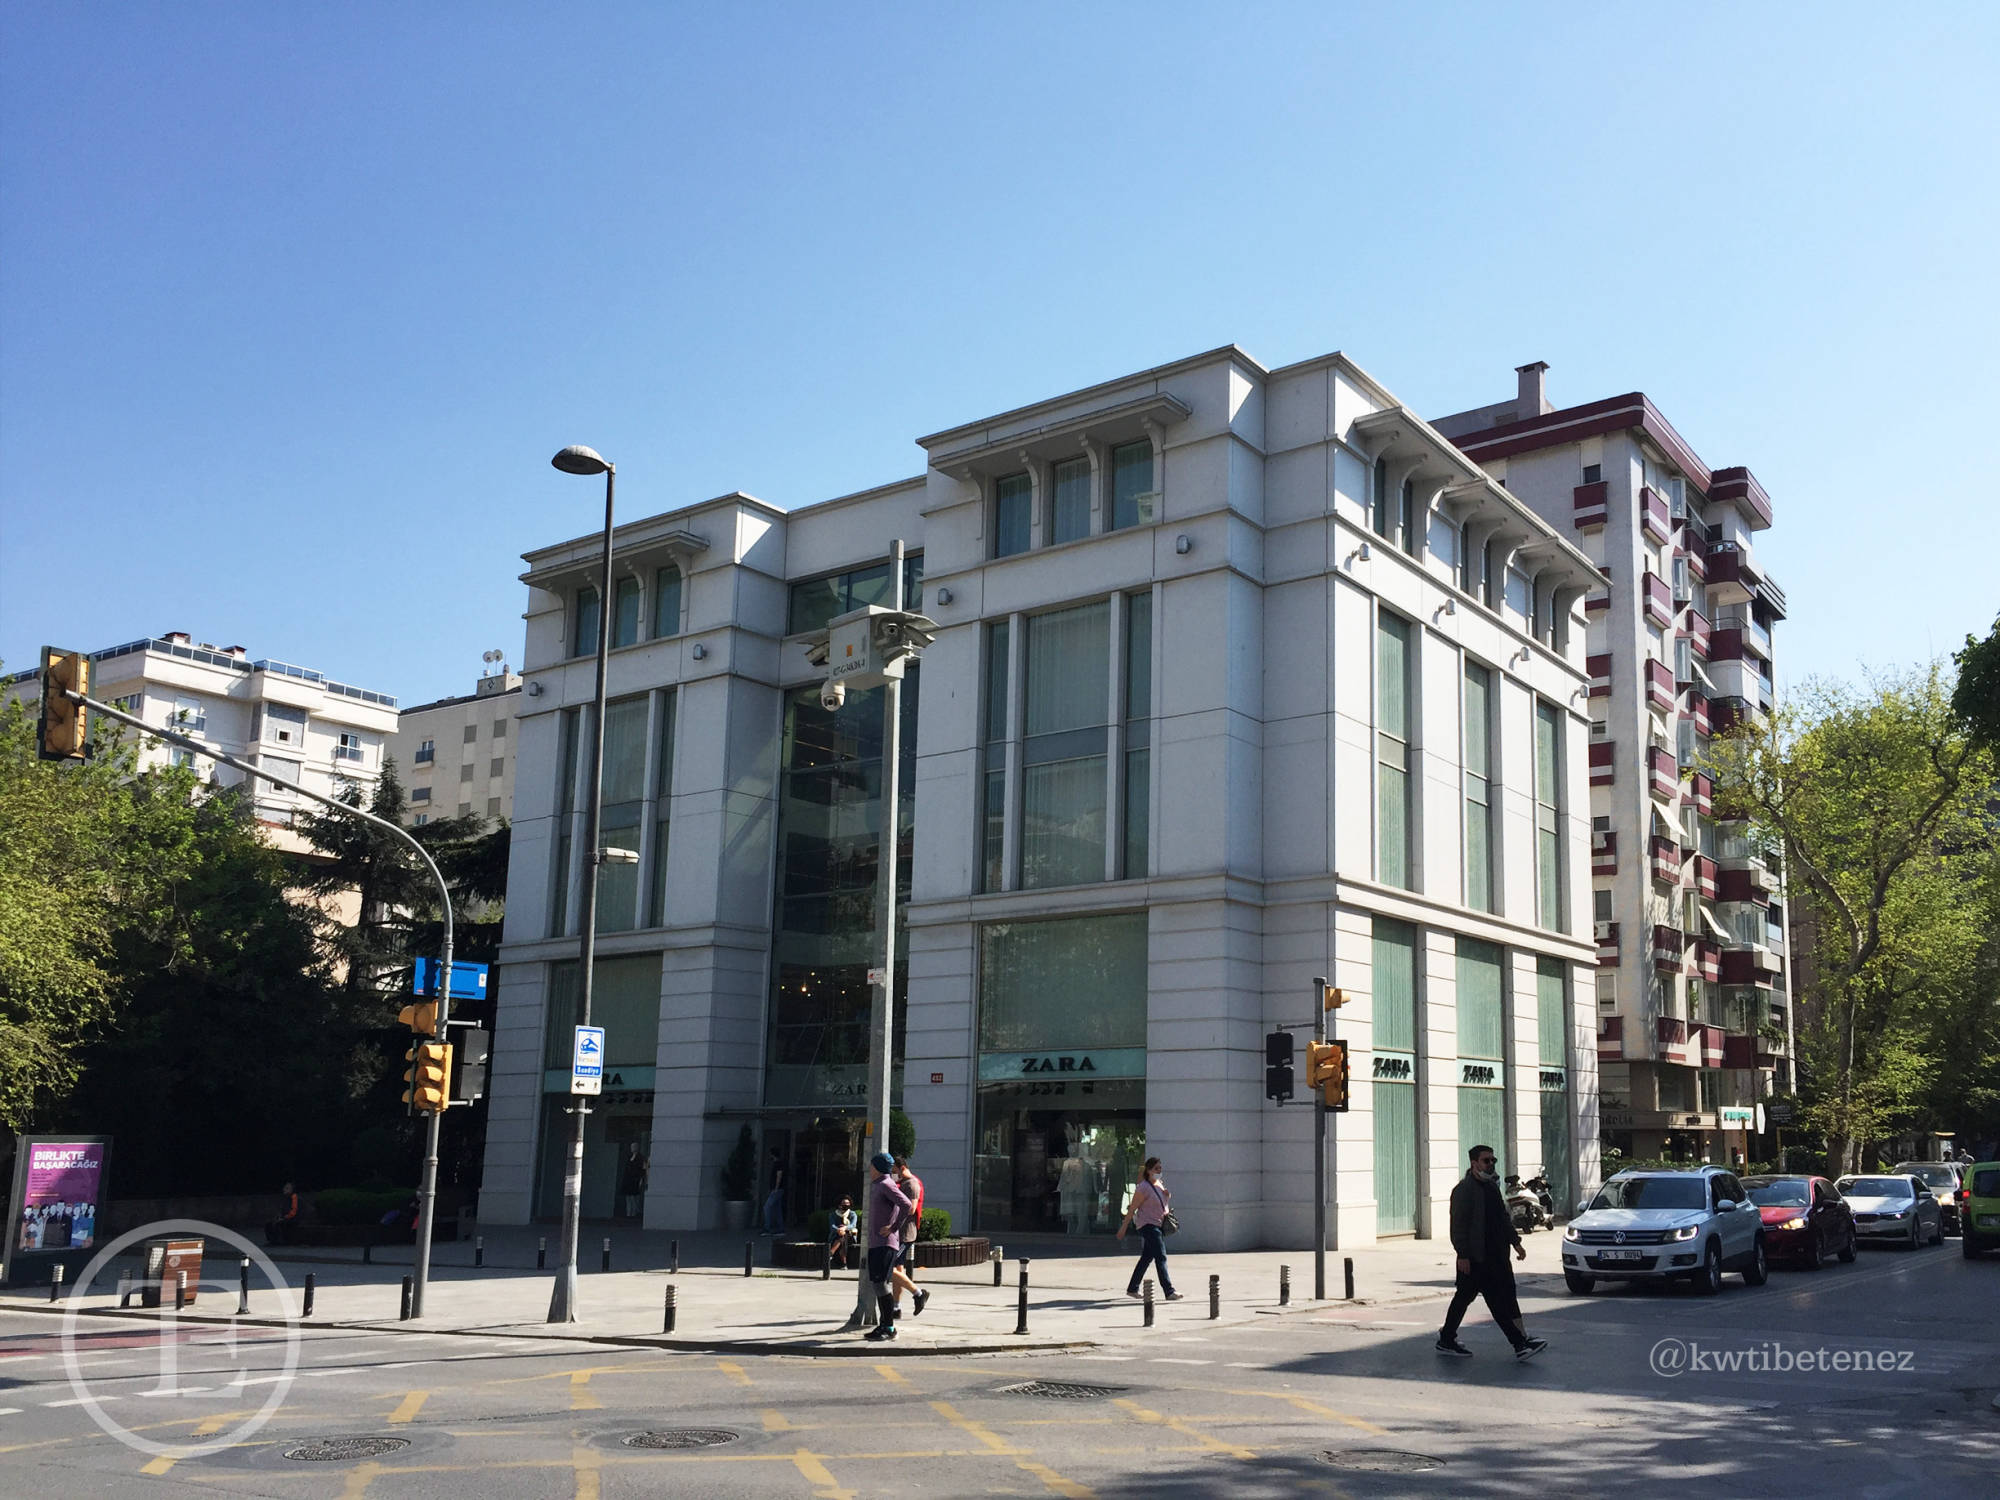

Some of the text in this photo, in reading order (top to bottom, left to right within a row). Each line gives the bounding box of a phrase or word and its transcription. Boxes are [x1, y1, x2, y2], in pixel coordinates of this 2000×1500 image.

[1022, 1056, 1096, 1073] ZARA
[1372, 1057, 1411, 1074] ZARA
[603, 1073, 625, 1085] RA
[1463, 1064, 1494, 1080] ZARA
[832, 1084, 867, 1096] ZAR
[33, 1160, 98, 1170] BAŞARACAĞIZ
